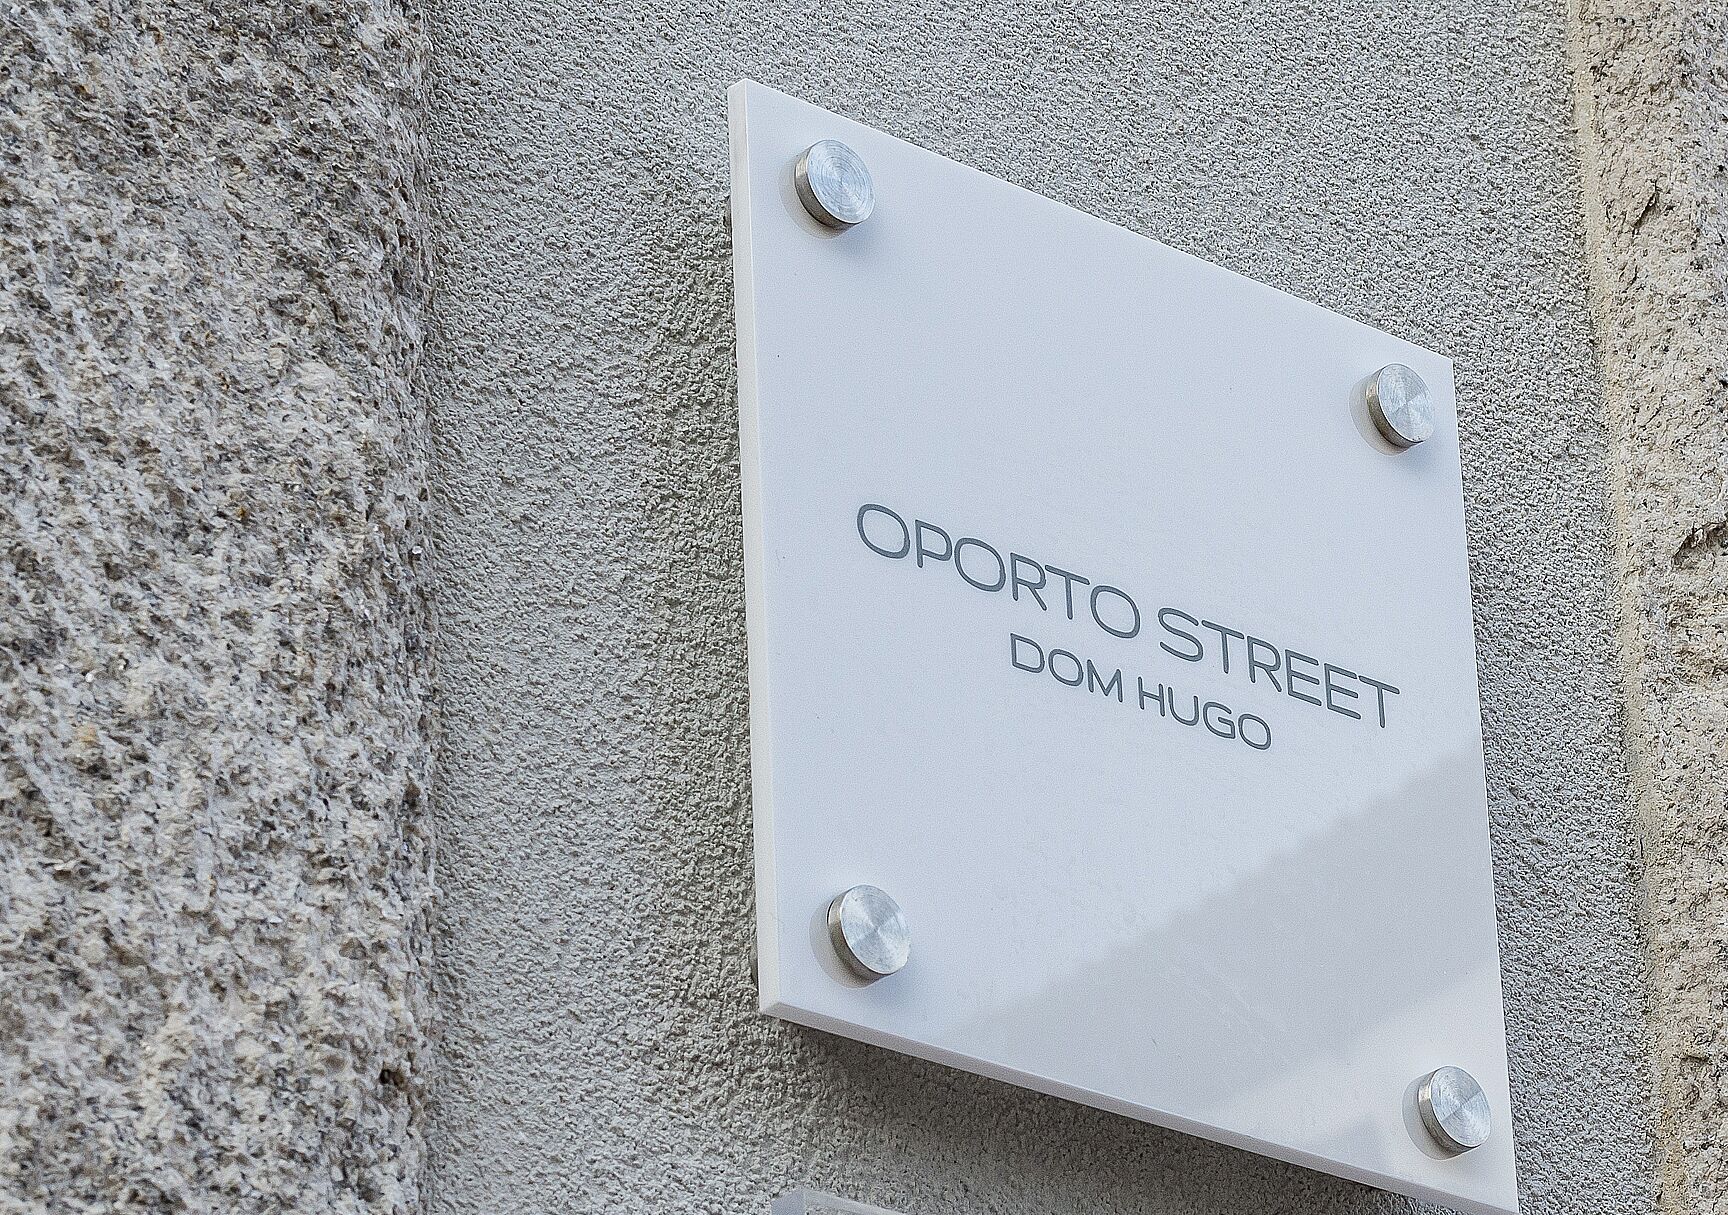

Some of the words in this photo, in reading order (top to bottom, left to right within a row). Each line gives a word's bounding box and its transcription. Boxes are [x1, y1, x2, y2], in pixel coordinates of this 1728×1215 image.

[856, 503, 1141, 639] OPORTO
[1157, 607, 1401, 729] STREET
[1009, 632, 1124, 703] DOM
[1137, 676, 1272, 751] HUGO
